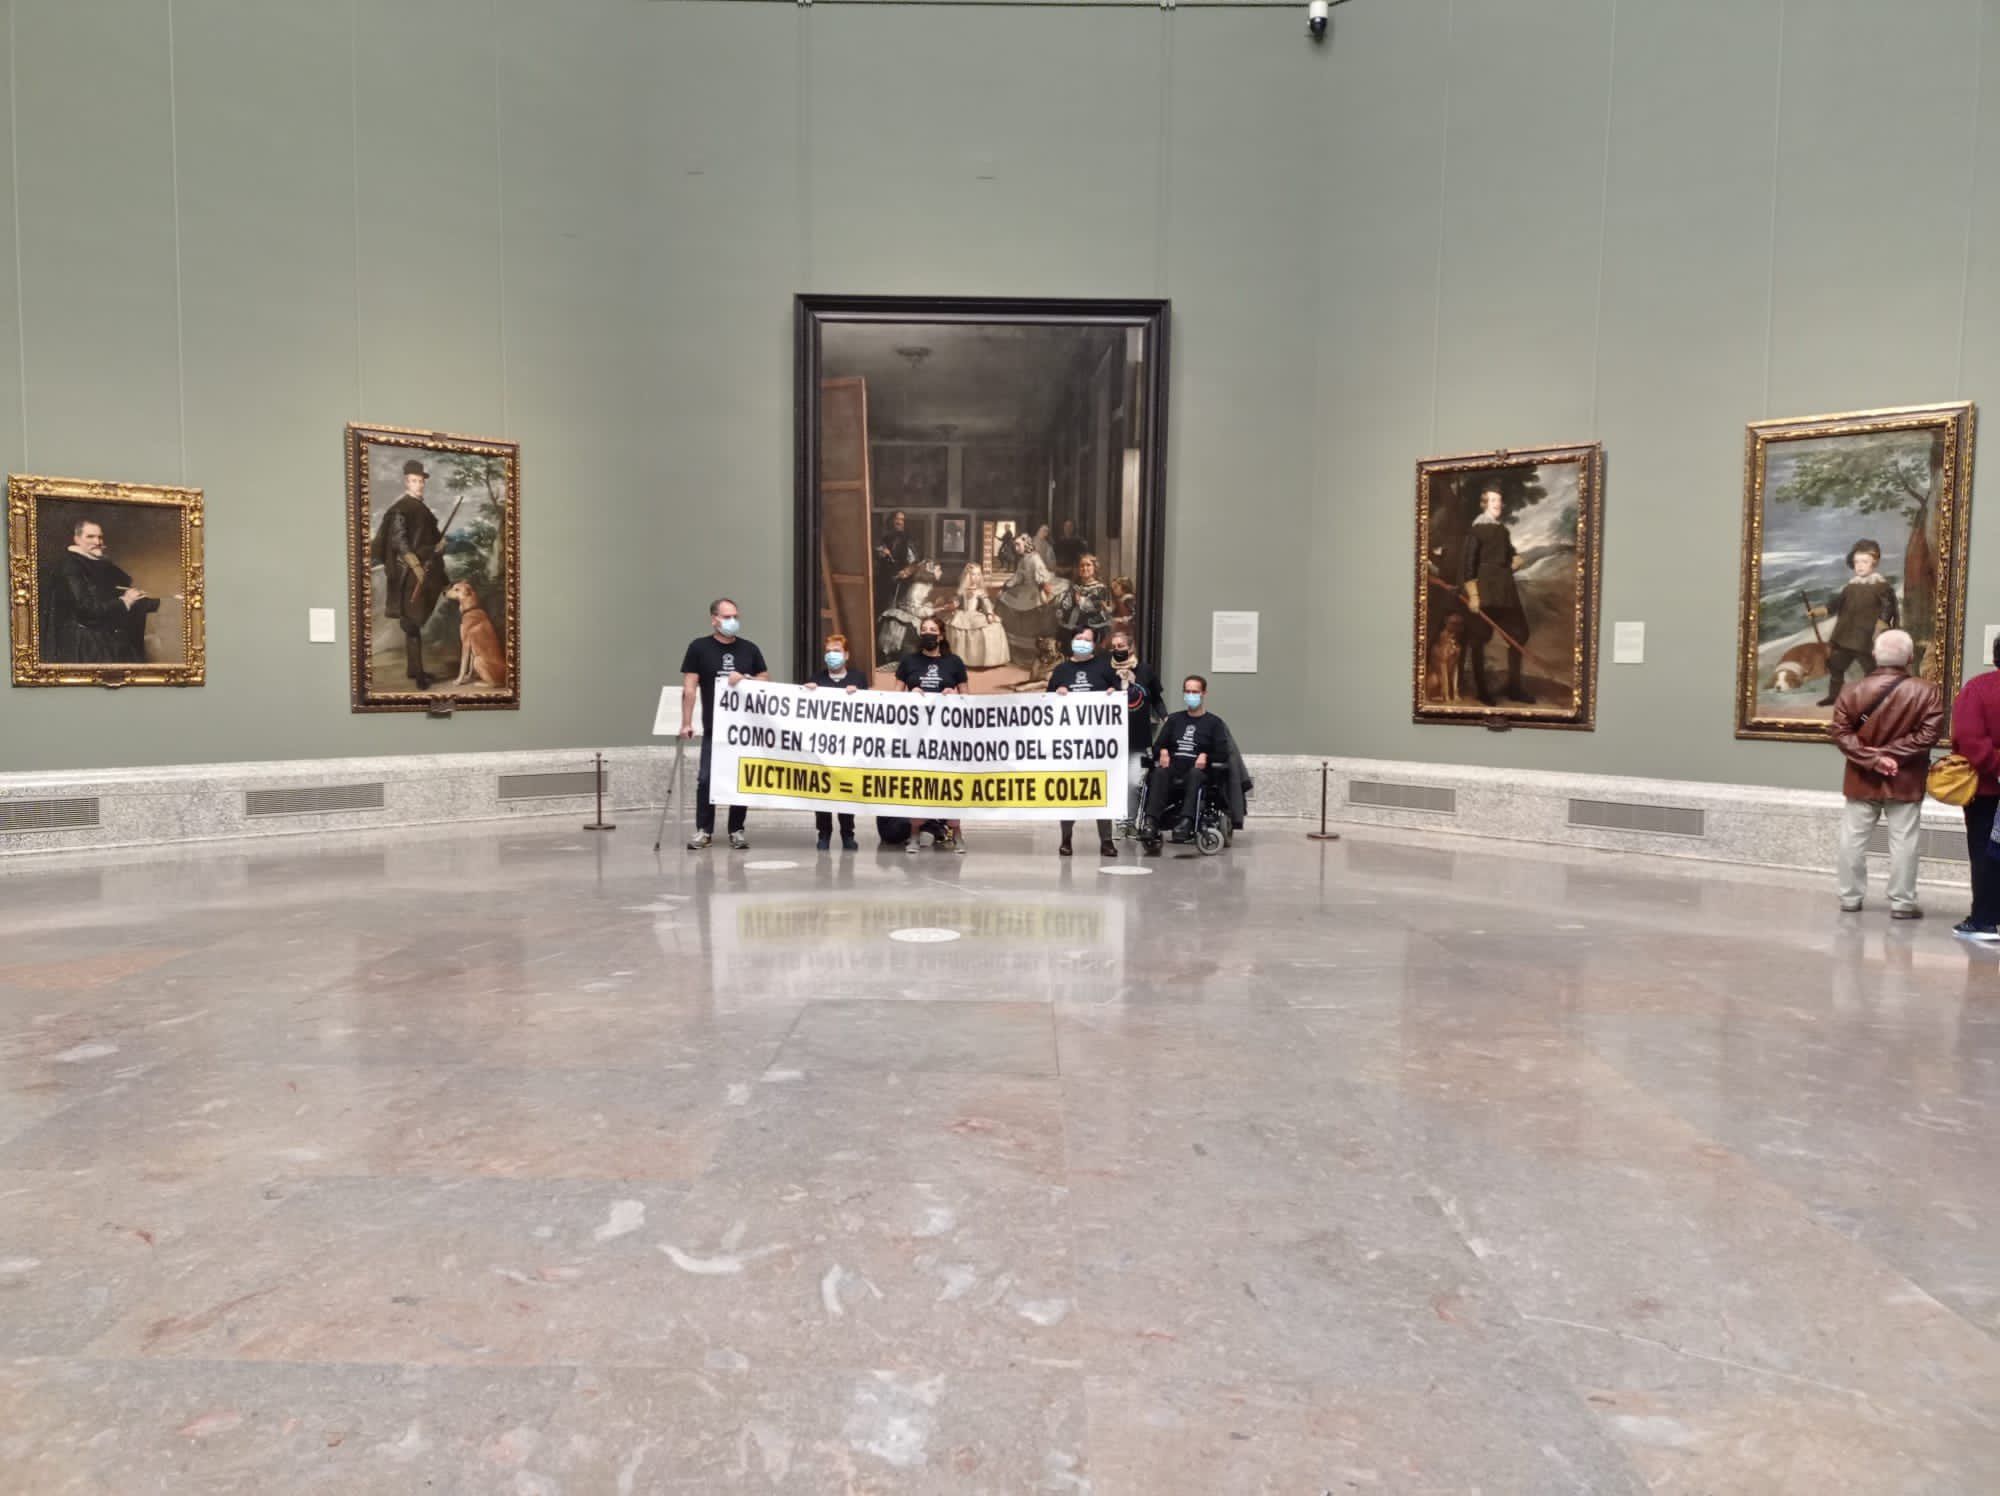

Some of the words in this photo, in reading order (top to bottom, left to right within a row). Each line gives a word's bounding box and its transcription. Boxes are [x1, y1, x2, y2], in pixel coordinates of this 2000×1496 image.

[720, 691, 739, 712] 40
[745, 690, 790, 717] AÑOS
[796, 698, 919, 726] ENVENENADOS
[925, 705, 936, 726] Y
[941, 705, 1054, 729] CONDENADOS
[1059, 705, 1071, 726] A
[1076, 704, 1123, 726] VIVIR
[727, 725, 776, 749] COMO
[781, 730, 802, 752] EN
[809, 733, 846, 756] 1981
[852, 736, 886, 758] POR
[891, 739, 912, 759] EL
[917, 738, 1010, 762] ABANDONO
[1016, 739, 1047, 760] DEL
[1052, 738, 1119, 760] ESTADO
[744, 763, 832, 794] VICTIMAS
[862, 775, 963, 802] ENFERMAS
[971, 777, 1036, 802] ACEITE
[1044, 777, 1102, 802] COLZA
